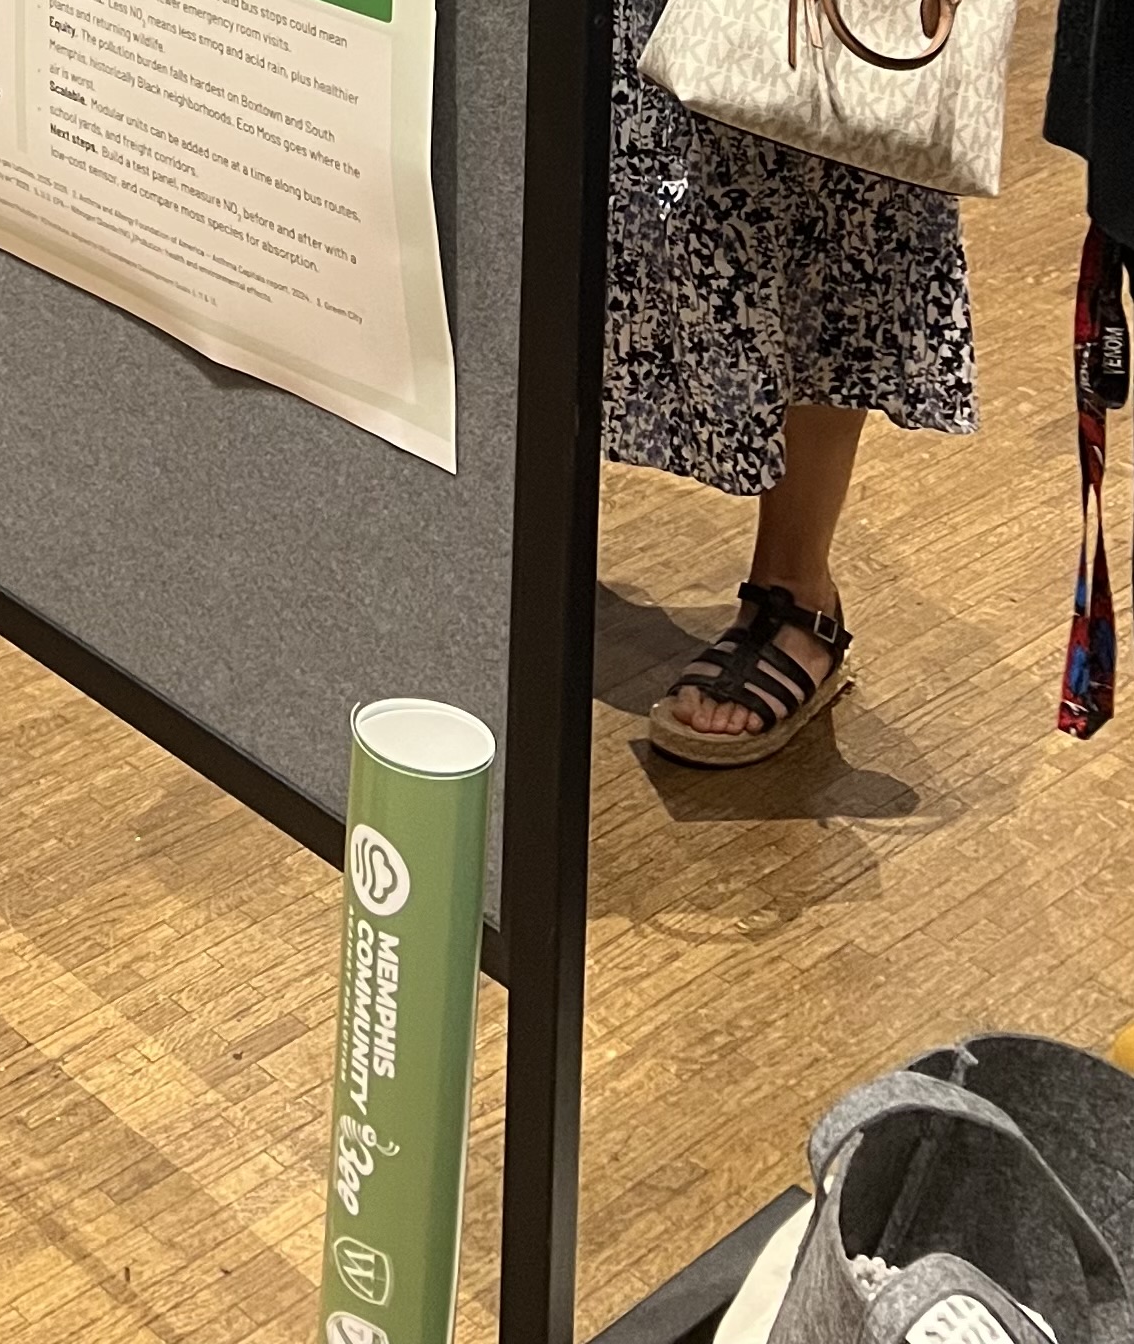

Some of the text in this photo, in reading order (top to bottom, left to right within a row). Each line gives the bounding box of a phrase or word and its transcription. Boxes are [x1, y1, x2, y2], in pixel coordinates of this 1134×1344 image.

[259, 7, 288, 26] stops
[288, 18, 317, 37] could
[318, 28, 348, 48] mean
[1102, 326, 1126, 375] VENOM
[353, 920, 374, 1116] COMMUNITY
[373, 931, 400, 1079] MEMPHIS
